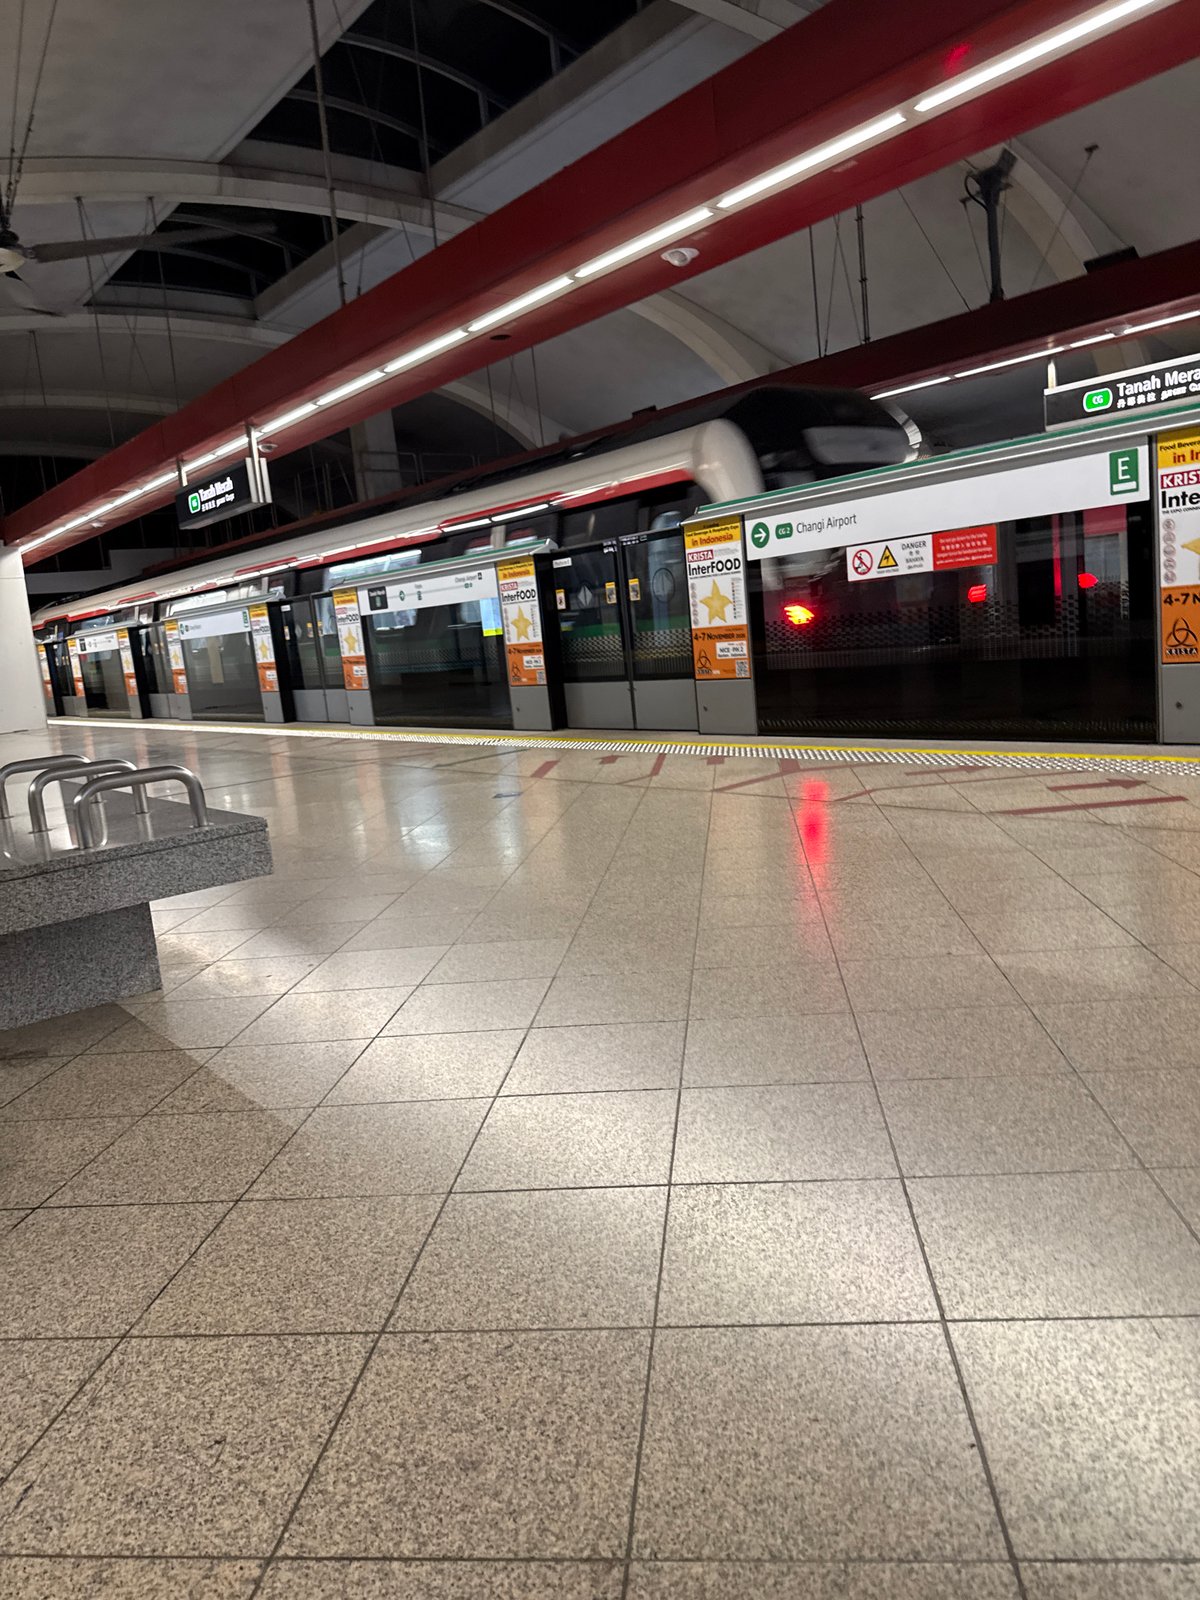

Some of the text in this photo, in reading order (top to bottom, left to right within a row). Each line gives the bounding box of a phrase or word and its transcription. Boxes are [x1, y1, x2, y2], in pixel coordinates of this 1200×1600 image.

[1116, 375, 1161, 397] Tanah
[1092, 395, 1104, 405] CG
[1160, 443, 1176, 452] Food
[1173, 452, 1186, 463] in
[1118, 457, 1131, 480] E
[1161, 490, 1200, 509] Inte
[796, 514, 857, 533] Changi Airport
[700, 533, 734, 545] Indonesia
[901, 540, 927, 550] DANGER
[688, 551, 713, 562] KRISTA
[688, 558, 741, 576] InterFOOD
[501, 589, 536, 602] InterFOOD
[1163, 593, 1190, 606] 4-7
[694, 632, 706, 641] 4-7
